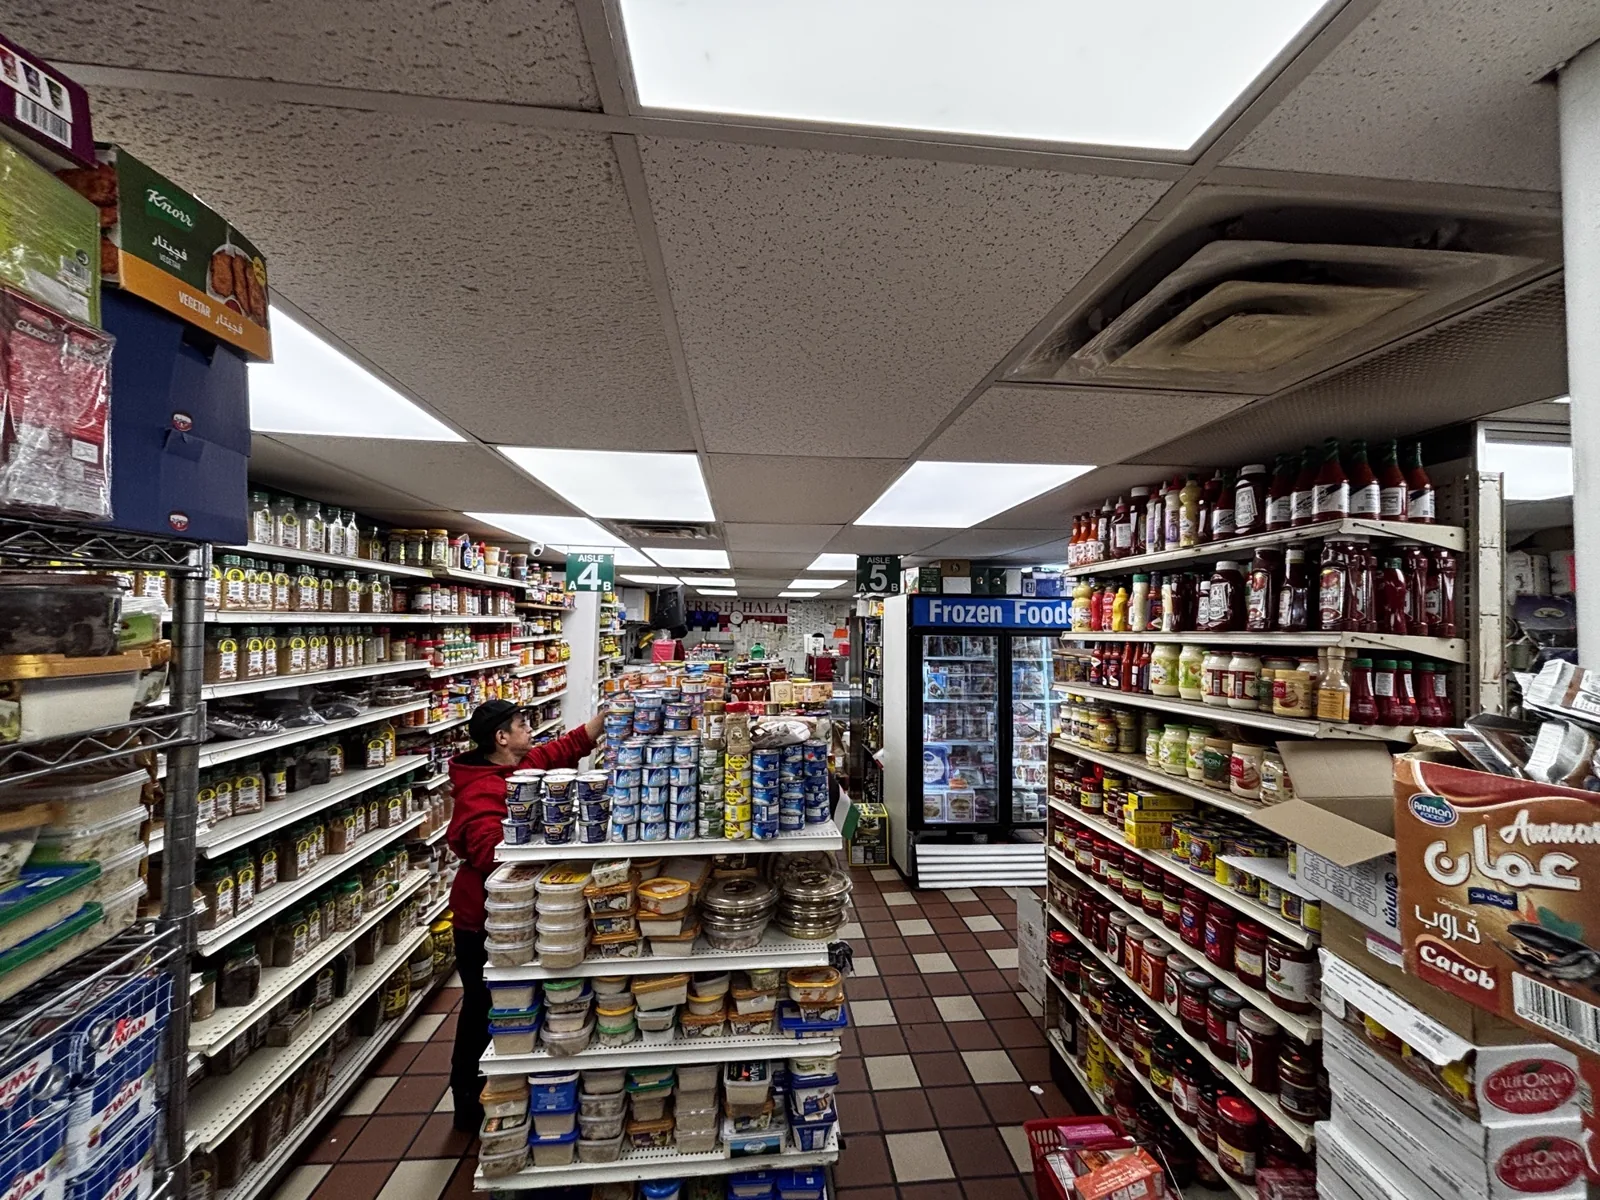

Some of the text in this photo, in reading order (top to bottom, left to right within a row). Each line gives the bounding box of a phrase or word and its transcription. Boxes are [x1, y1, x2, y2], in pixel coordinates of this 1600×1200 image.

[147, 189, 194, 227] Knorr
[179, 291, 211, 318] VEGETAR
[568, 563, 611, 591] A 4 B
[859, 564, 898, 591] A 5 B
[929, 600, 1002, 623] Frozen
[1414, 801, 1452, 818] Amman
[1424, 824, 1582, 891] عمان
[1415, 904, 1481, 944] خروب
[1420, 945, 1495, 990] Carob
[1489, 1072, 1571, 1090] CALIFORNIA
[102, 1078, 143, 1122] ZWAN
[1504, 1087, 1561, 1103] GARDEN
